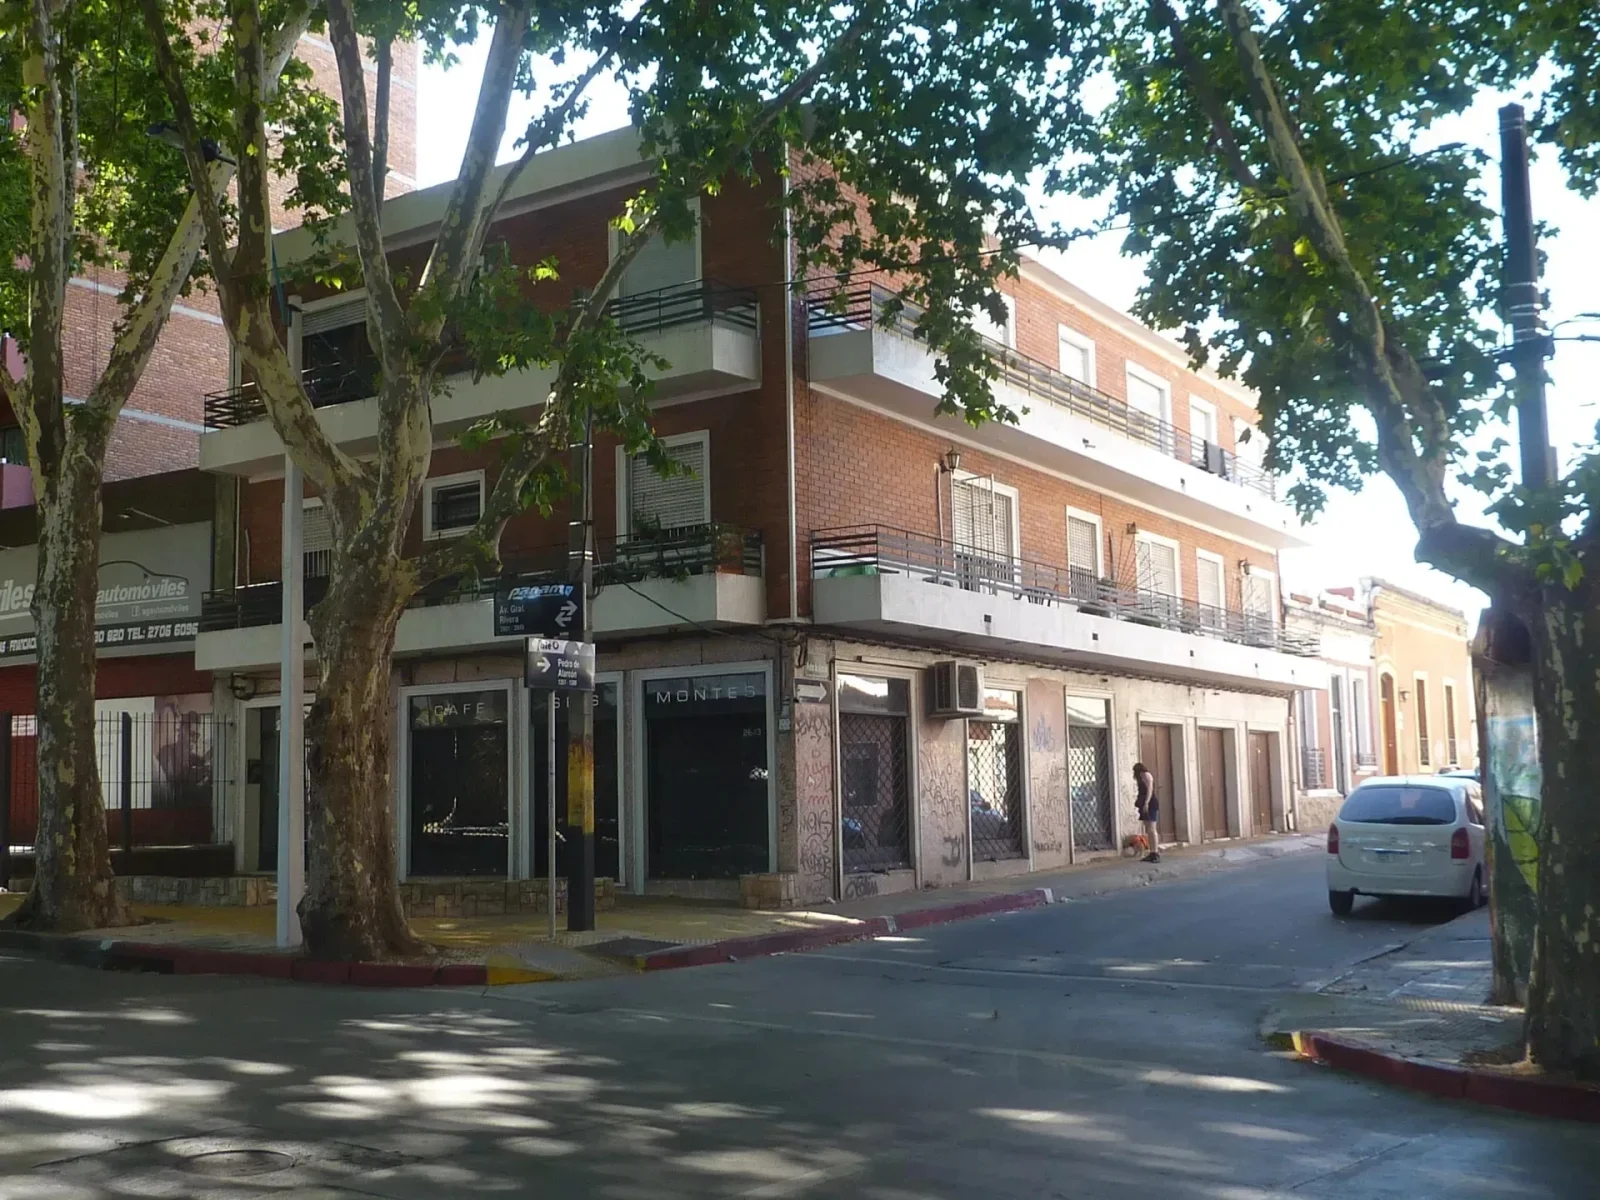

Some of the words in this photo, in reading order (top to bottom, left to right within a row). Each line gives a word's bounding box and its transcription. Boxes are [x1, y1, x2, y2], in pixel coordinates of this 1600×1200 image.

[95, 578, 186, 604] automóviles
[510, 604, 525, 613] Gral.
[499, 616, 519, 624] Rivera
[128, 626, 145, 640] TEL:
[147, 624, 171, 638] 2706
[557, 658, 573, 667] Pedro
[573, 660, 580, 668] de
[656, 685, 756, 704] MONTES
[434, 702, 485, 717] CAFE
